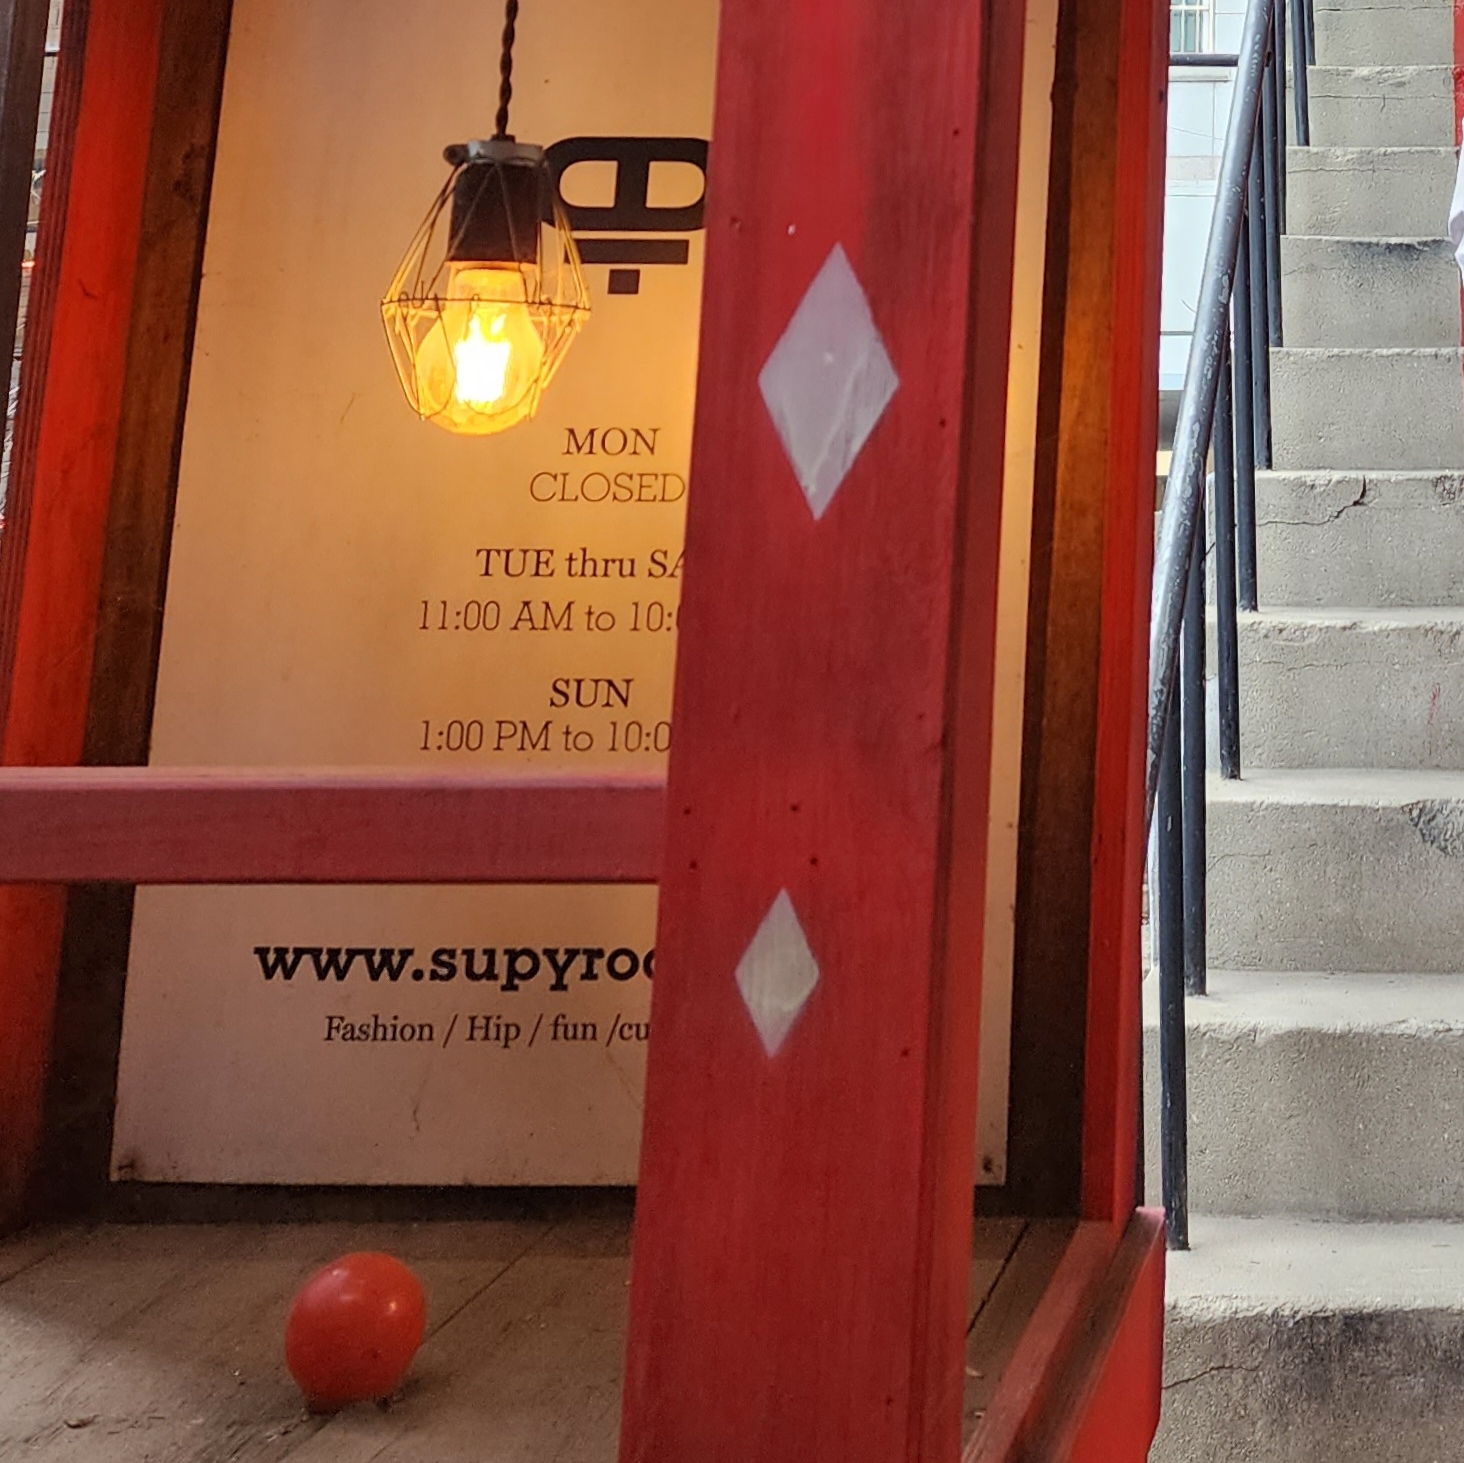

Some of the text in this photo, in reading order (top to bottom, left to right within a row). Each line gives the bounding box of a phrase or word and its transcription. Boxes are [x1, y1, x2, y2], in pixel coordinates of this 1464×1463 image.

[562, 427, 661, 455] MON
[530, 472, 686, 502] CLOSED
[476, 548, 555, 578] TUE
[565, 547, 635, 578] thru
[419, 600, 681, 632] 11:00 AM to 10:
[549, 678, 634, 708] SUN
[420, 720, 483, 751] 1:00
[493, 720, 552, 751] PM
[562, 724, 594, 752] to
[323, 1015, 434, 1042] Fashion
[465, 1015, 521, 1048] Hip
[550, 1014, 598, 1041] fun
